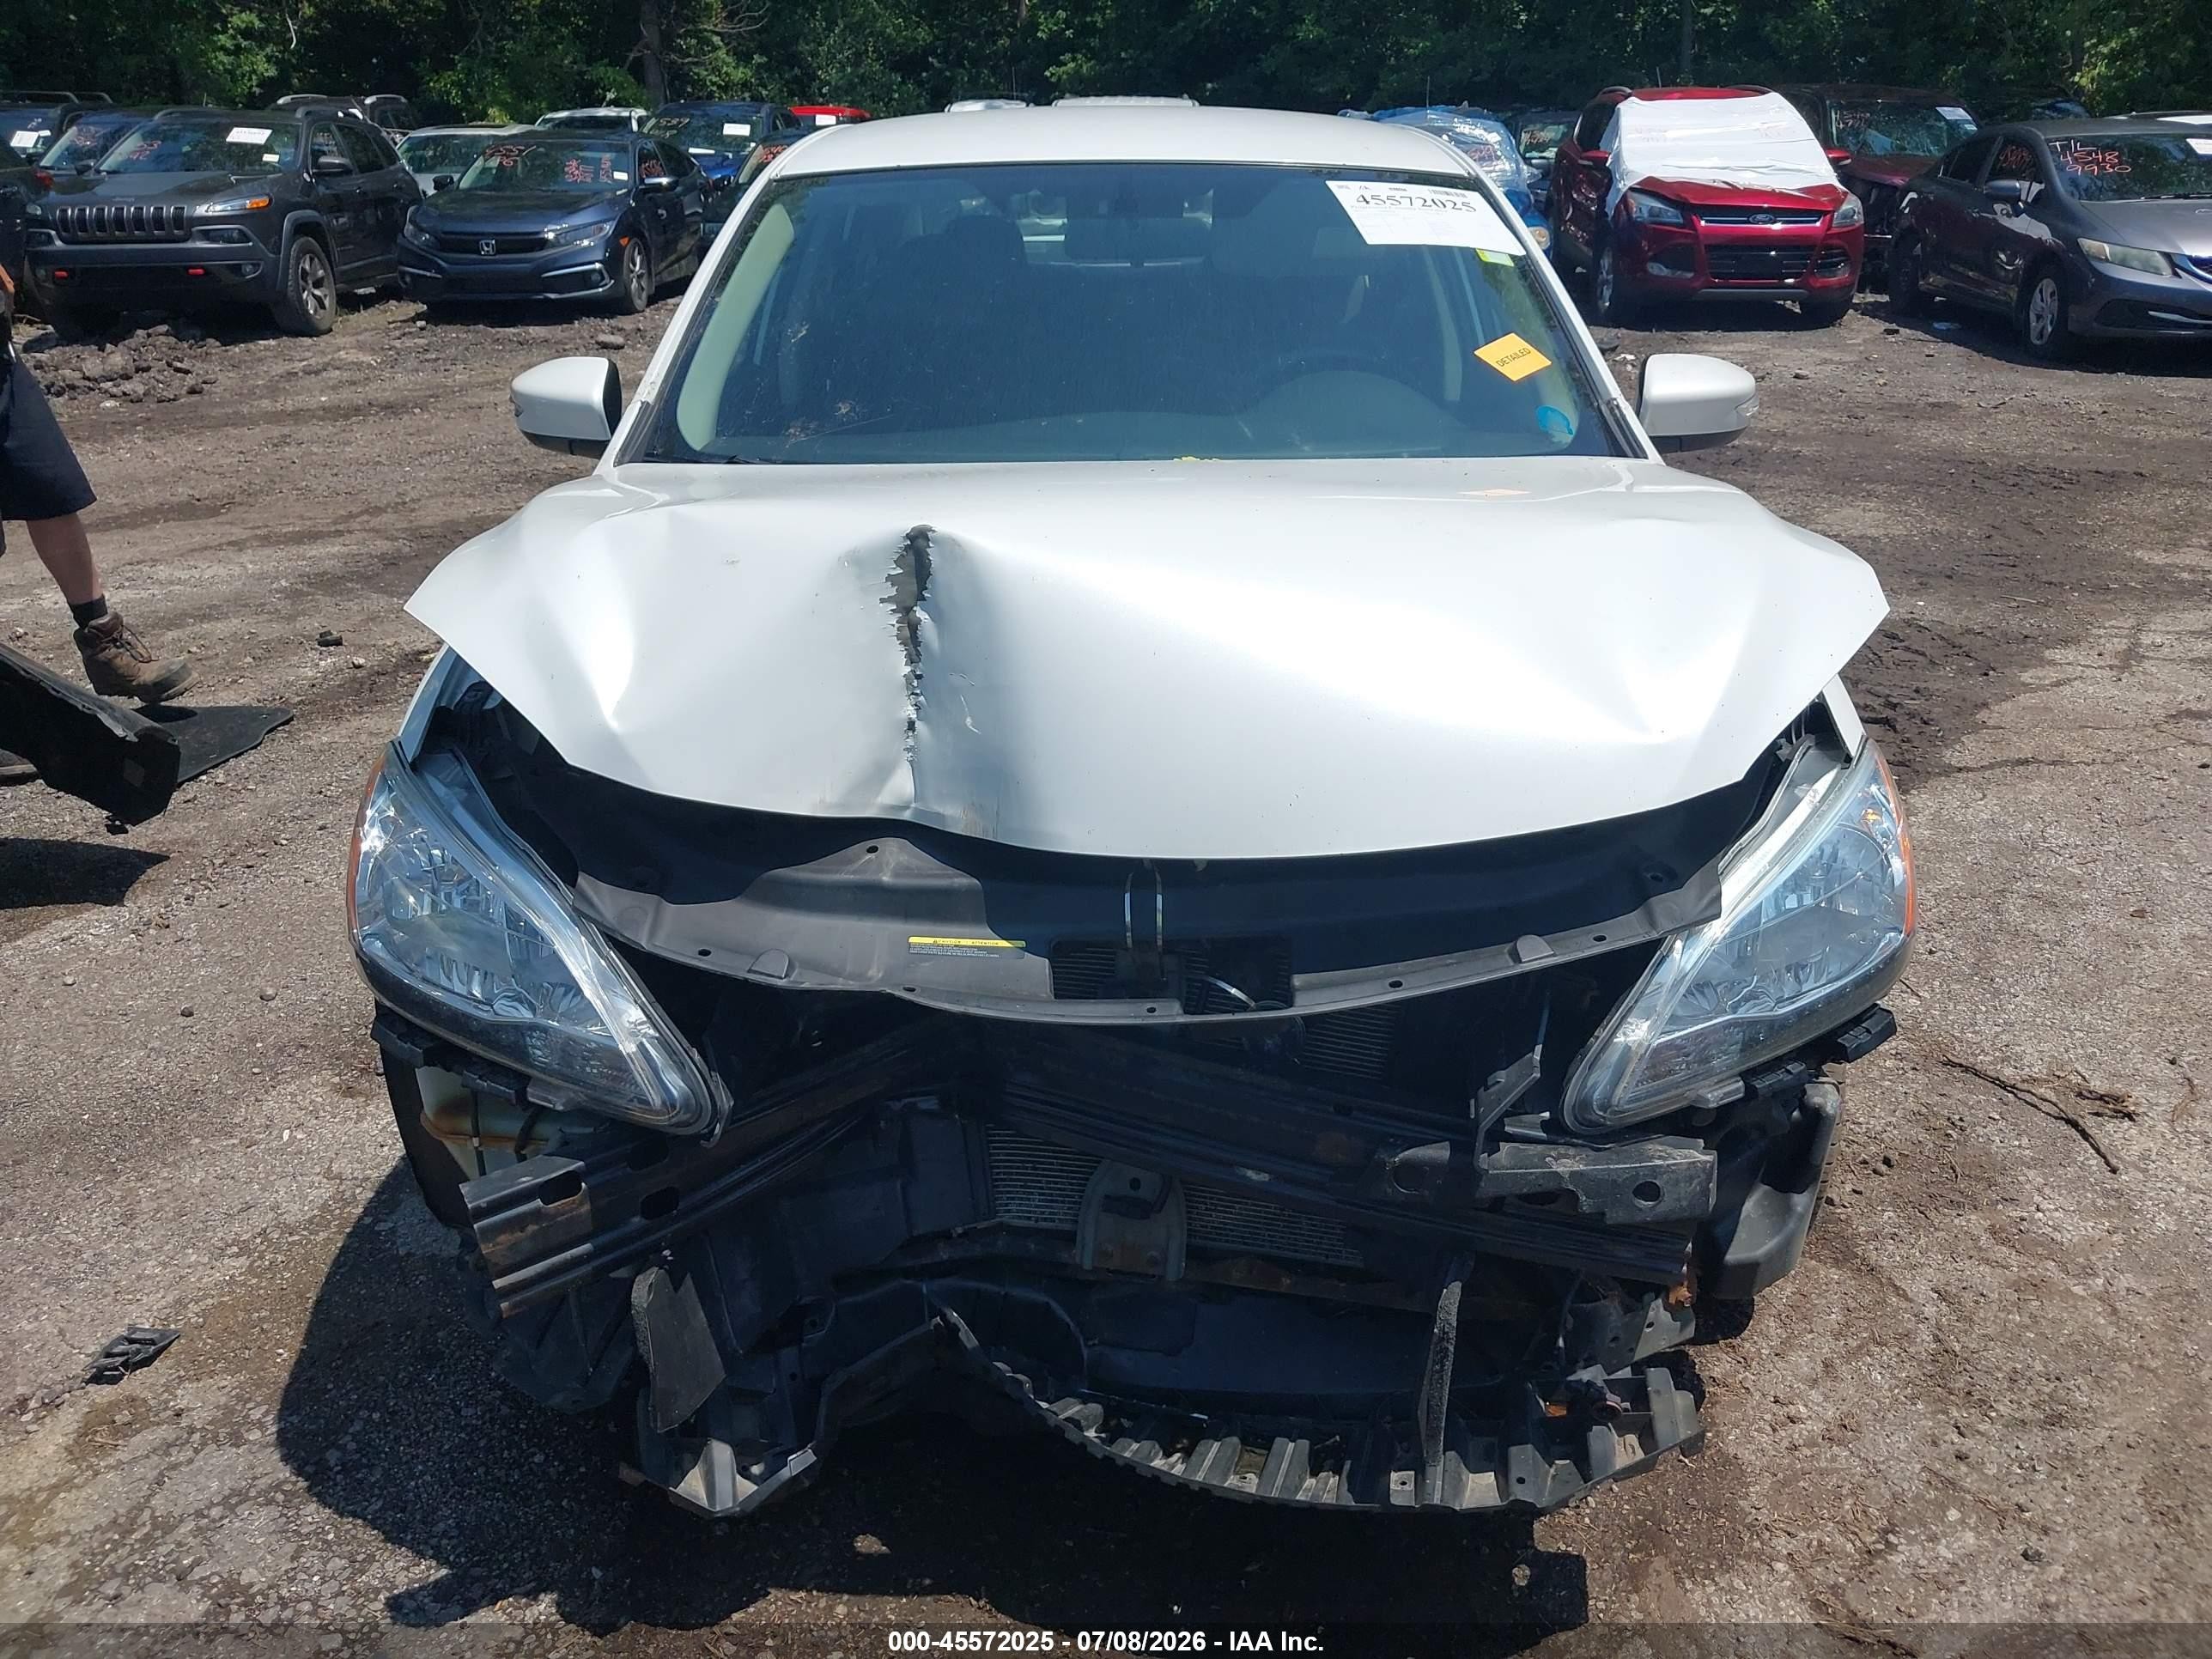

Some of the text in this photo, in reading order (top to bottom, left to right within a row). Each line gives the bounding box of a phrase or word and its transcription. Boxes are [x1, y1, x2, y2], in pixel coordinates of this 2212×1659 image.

[2061, 150, 2119, 165] 4548
[2066, 163, 2131, 176] 9930
[1356, 194, 1477, 213] 45572025
[1496, 348, 1531, 367] DETAILED
